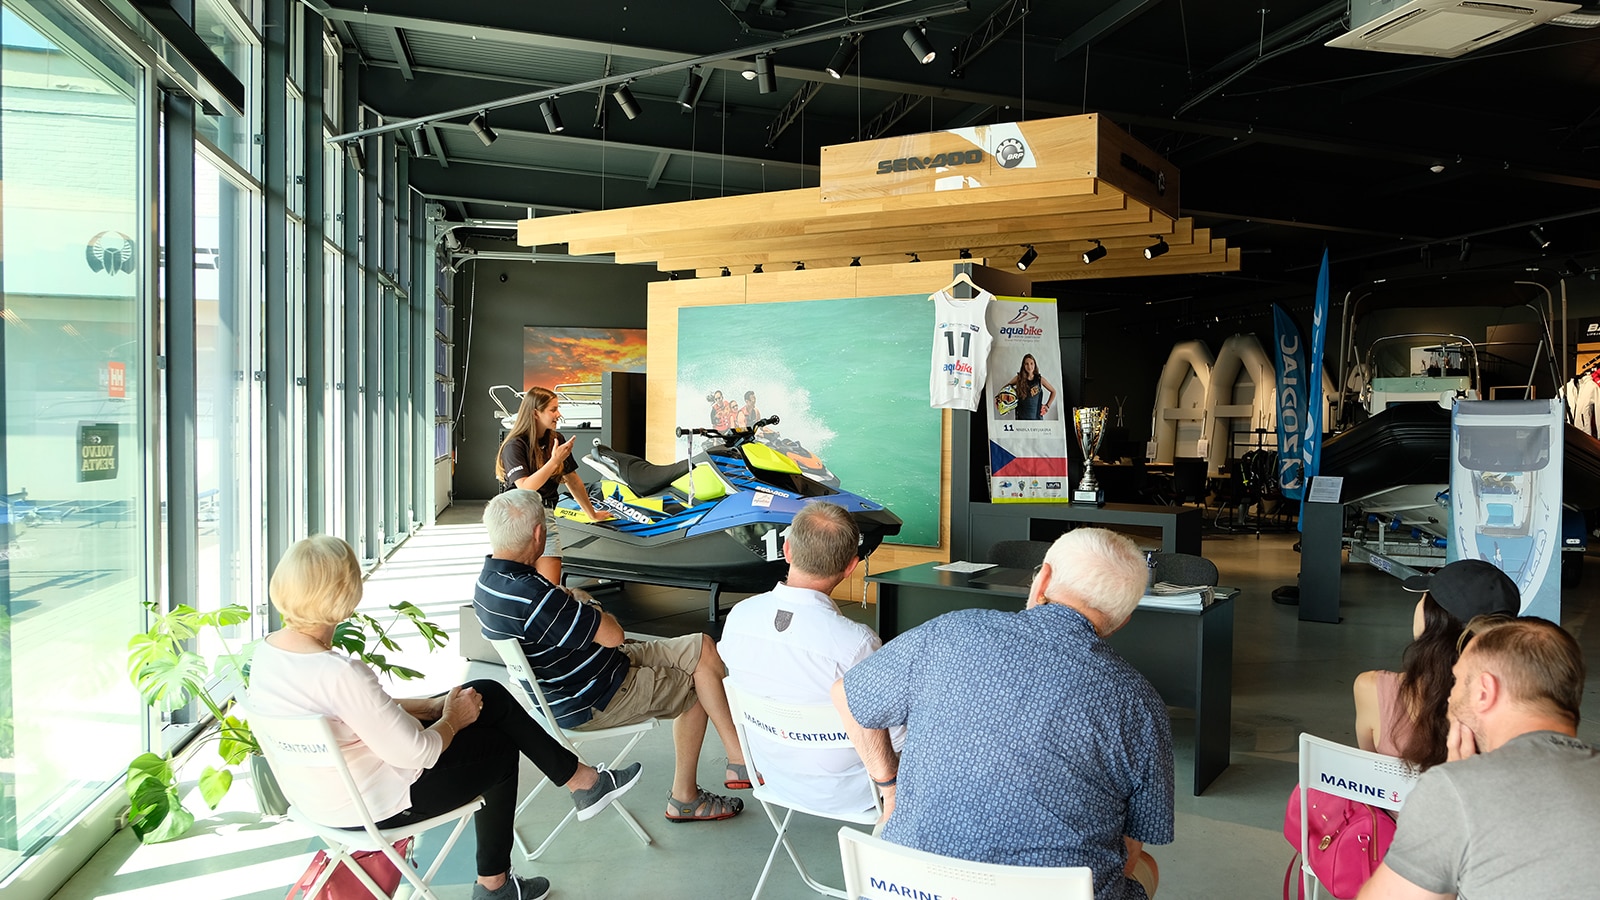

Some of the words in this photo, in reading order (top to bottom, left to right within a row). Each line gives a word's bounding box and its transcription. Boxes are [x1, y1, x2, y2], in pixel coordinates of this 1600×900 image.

[1006, 152, 1024, 161] BRP
[944, 330, 972, 358] 11
[1000, 323, 1043, 339] aquabike
[743, 711, 779, 736] MARINE
[788, 731, 850, 742] CENTRUM
[1320, 772, 1386, 800] MARINE
